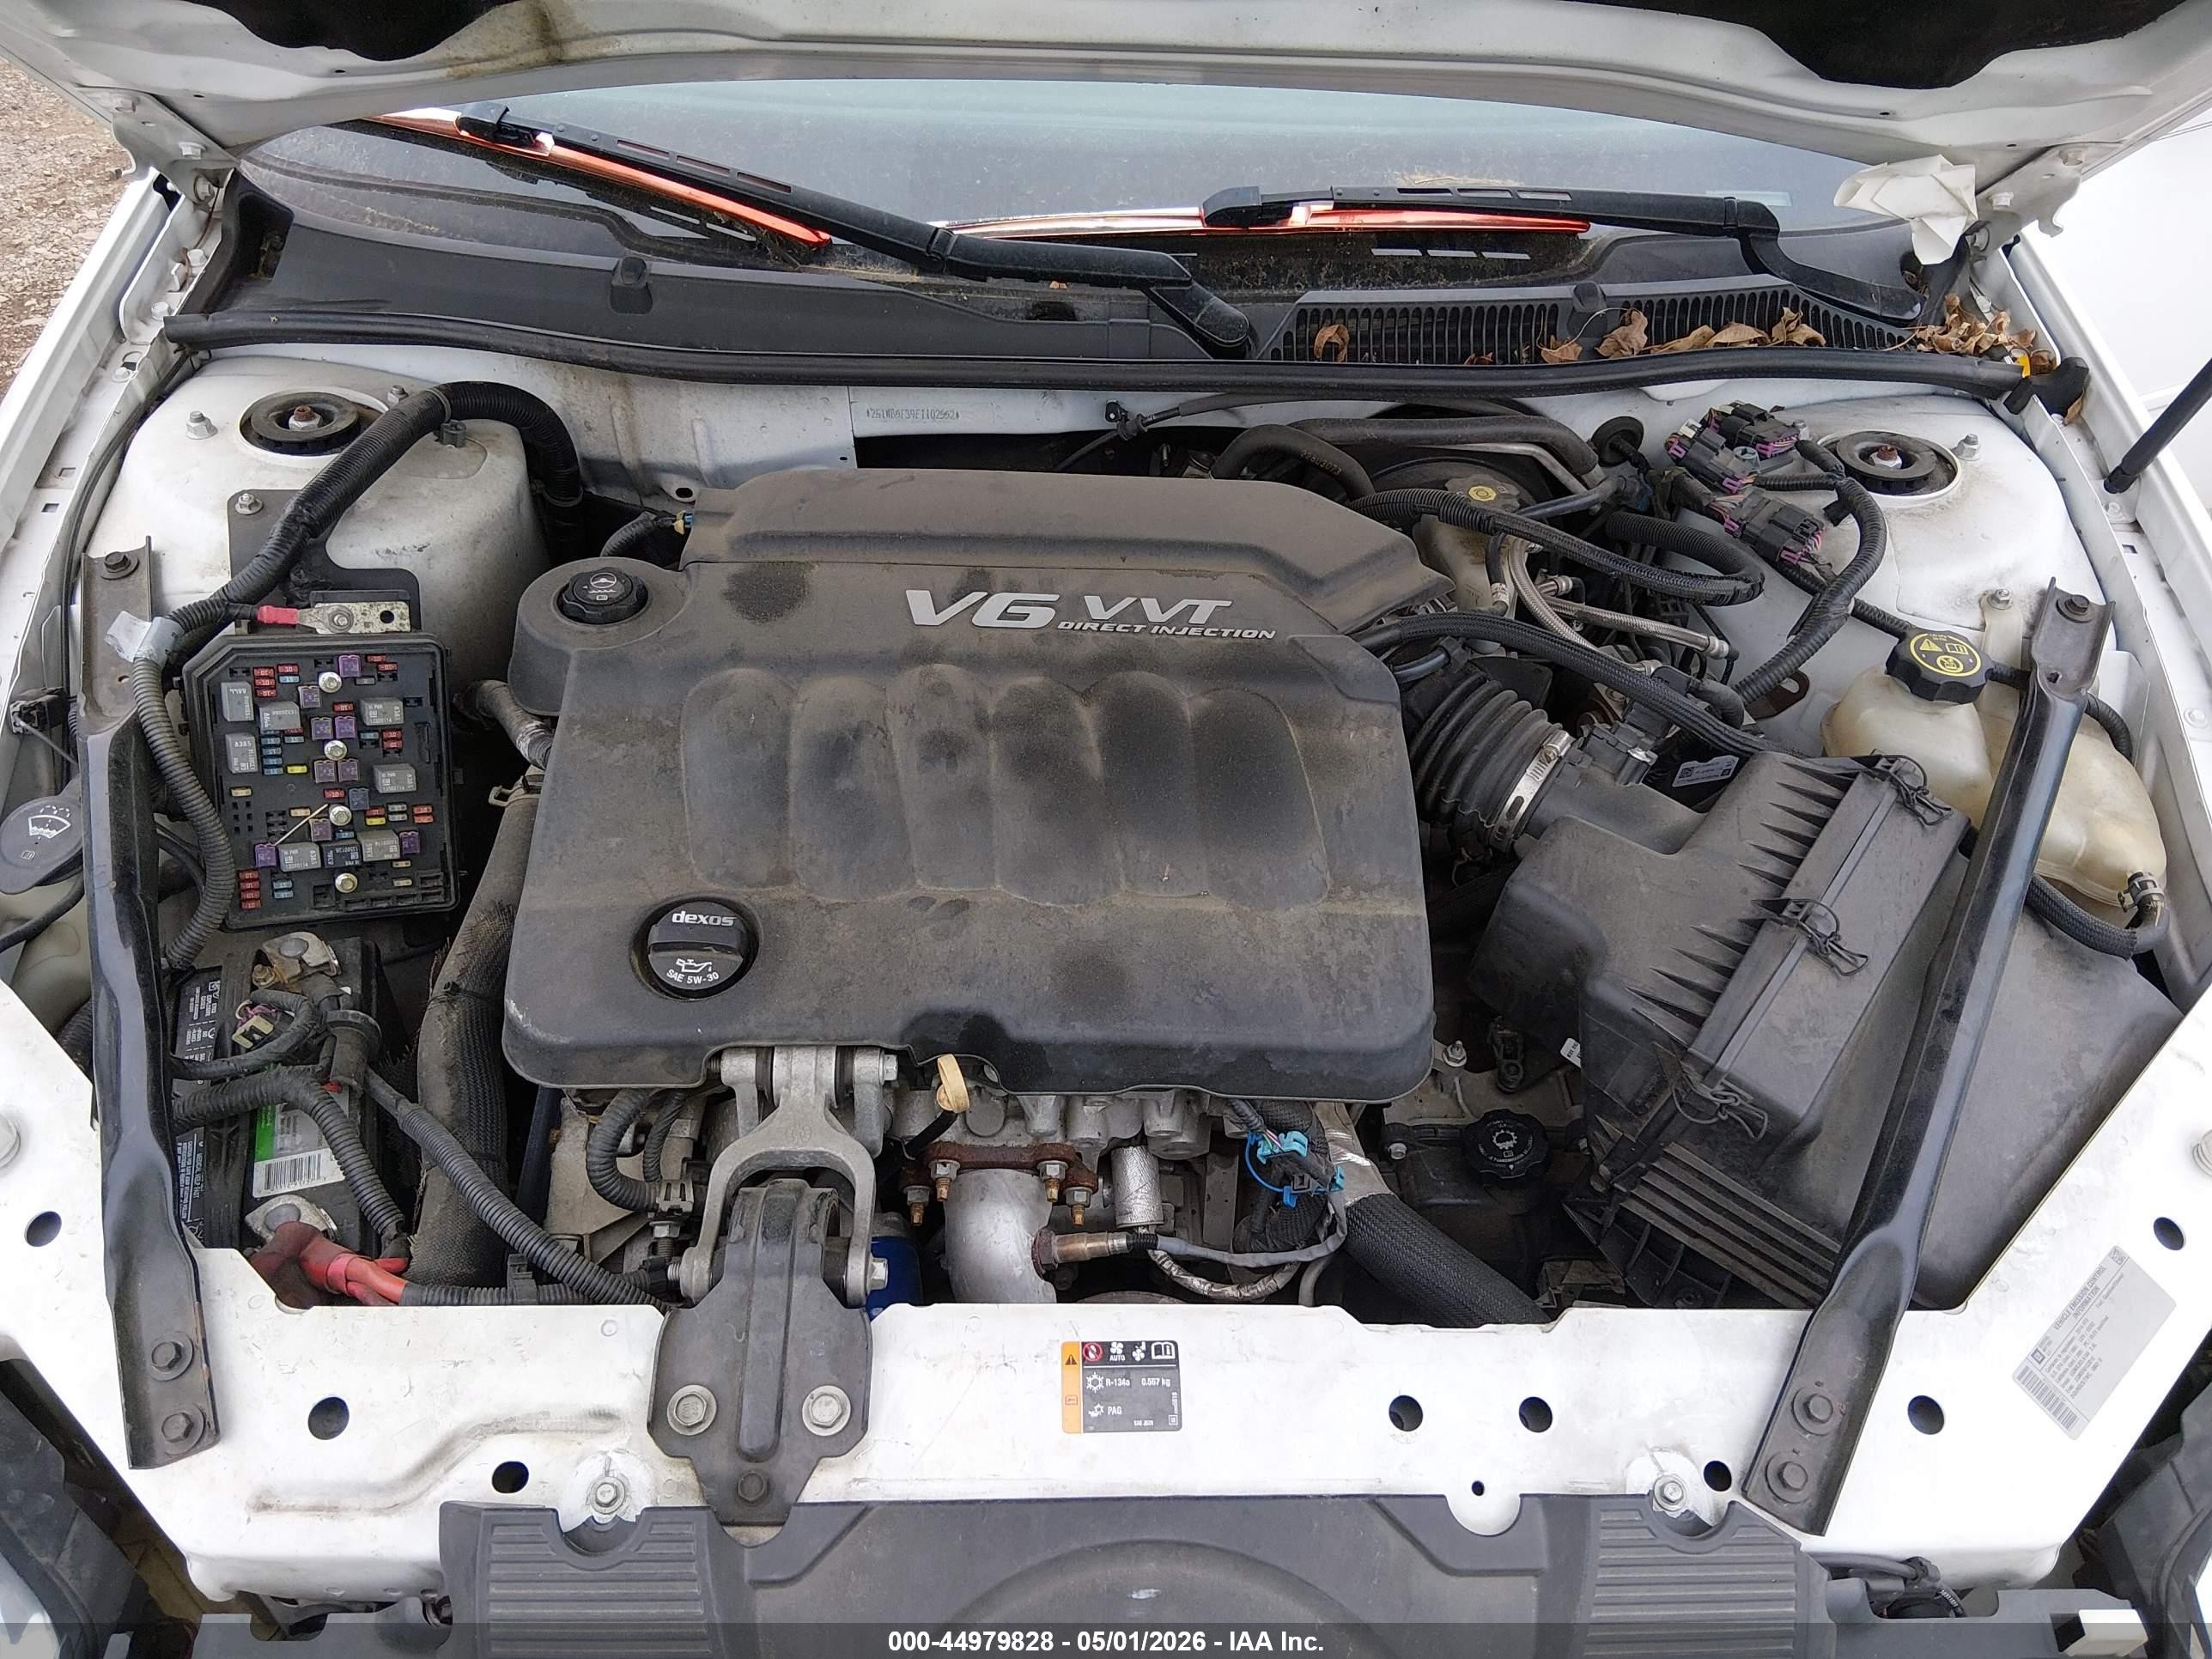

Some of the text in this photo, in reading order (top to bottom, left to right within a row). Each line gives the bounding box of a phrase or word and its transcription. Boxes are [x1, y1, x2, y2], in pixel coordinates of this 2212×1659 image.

[905, 589, 1233, 629] V6 VVT
[1057, 620, 1276, 640] DIRECT INJECTION
[672, 911, 737, 927] dexos
[666, 969, 719, 984] SAE 5W-30
[2068, 1285, 2089, 1311] EMISSION
[2086, 1263, 2106, 1288] CONTROL
[2070, 1284, 2100, 1320] INFORMATION
[1106, 1378, 1130, 1387] R-134a
[1161, 1378, 1170, 1387] kg
[1108, 1407, 1122, 1415] PAG
